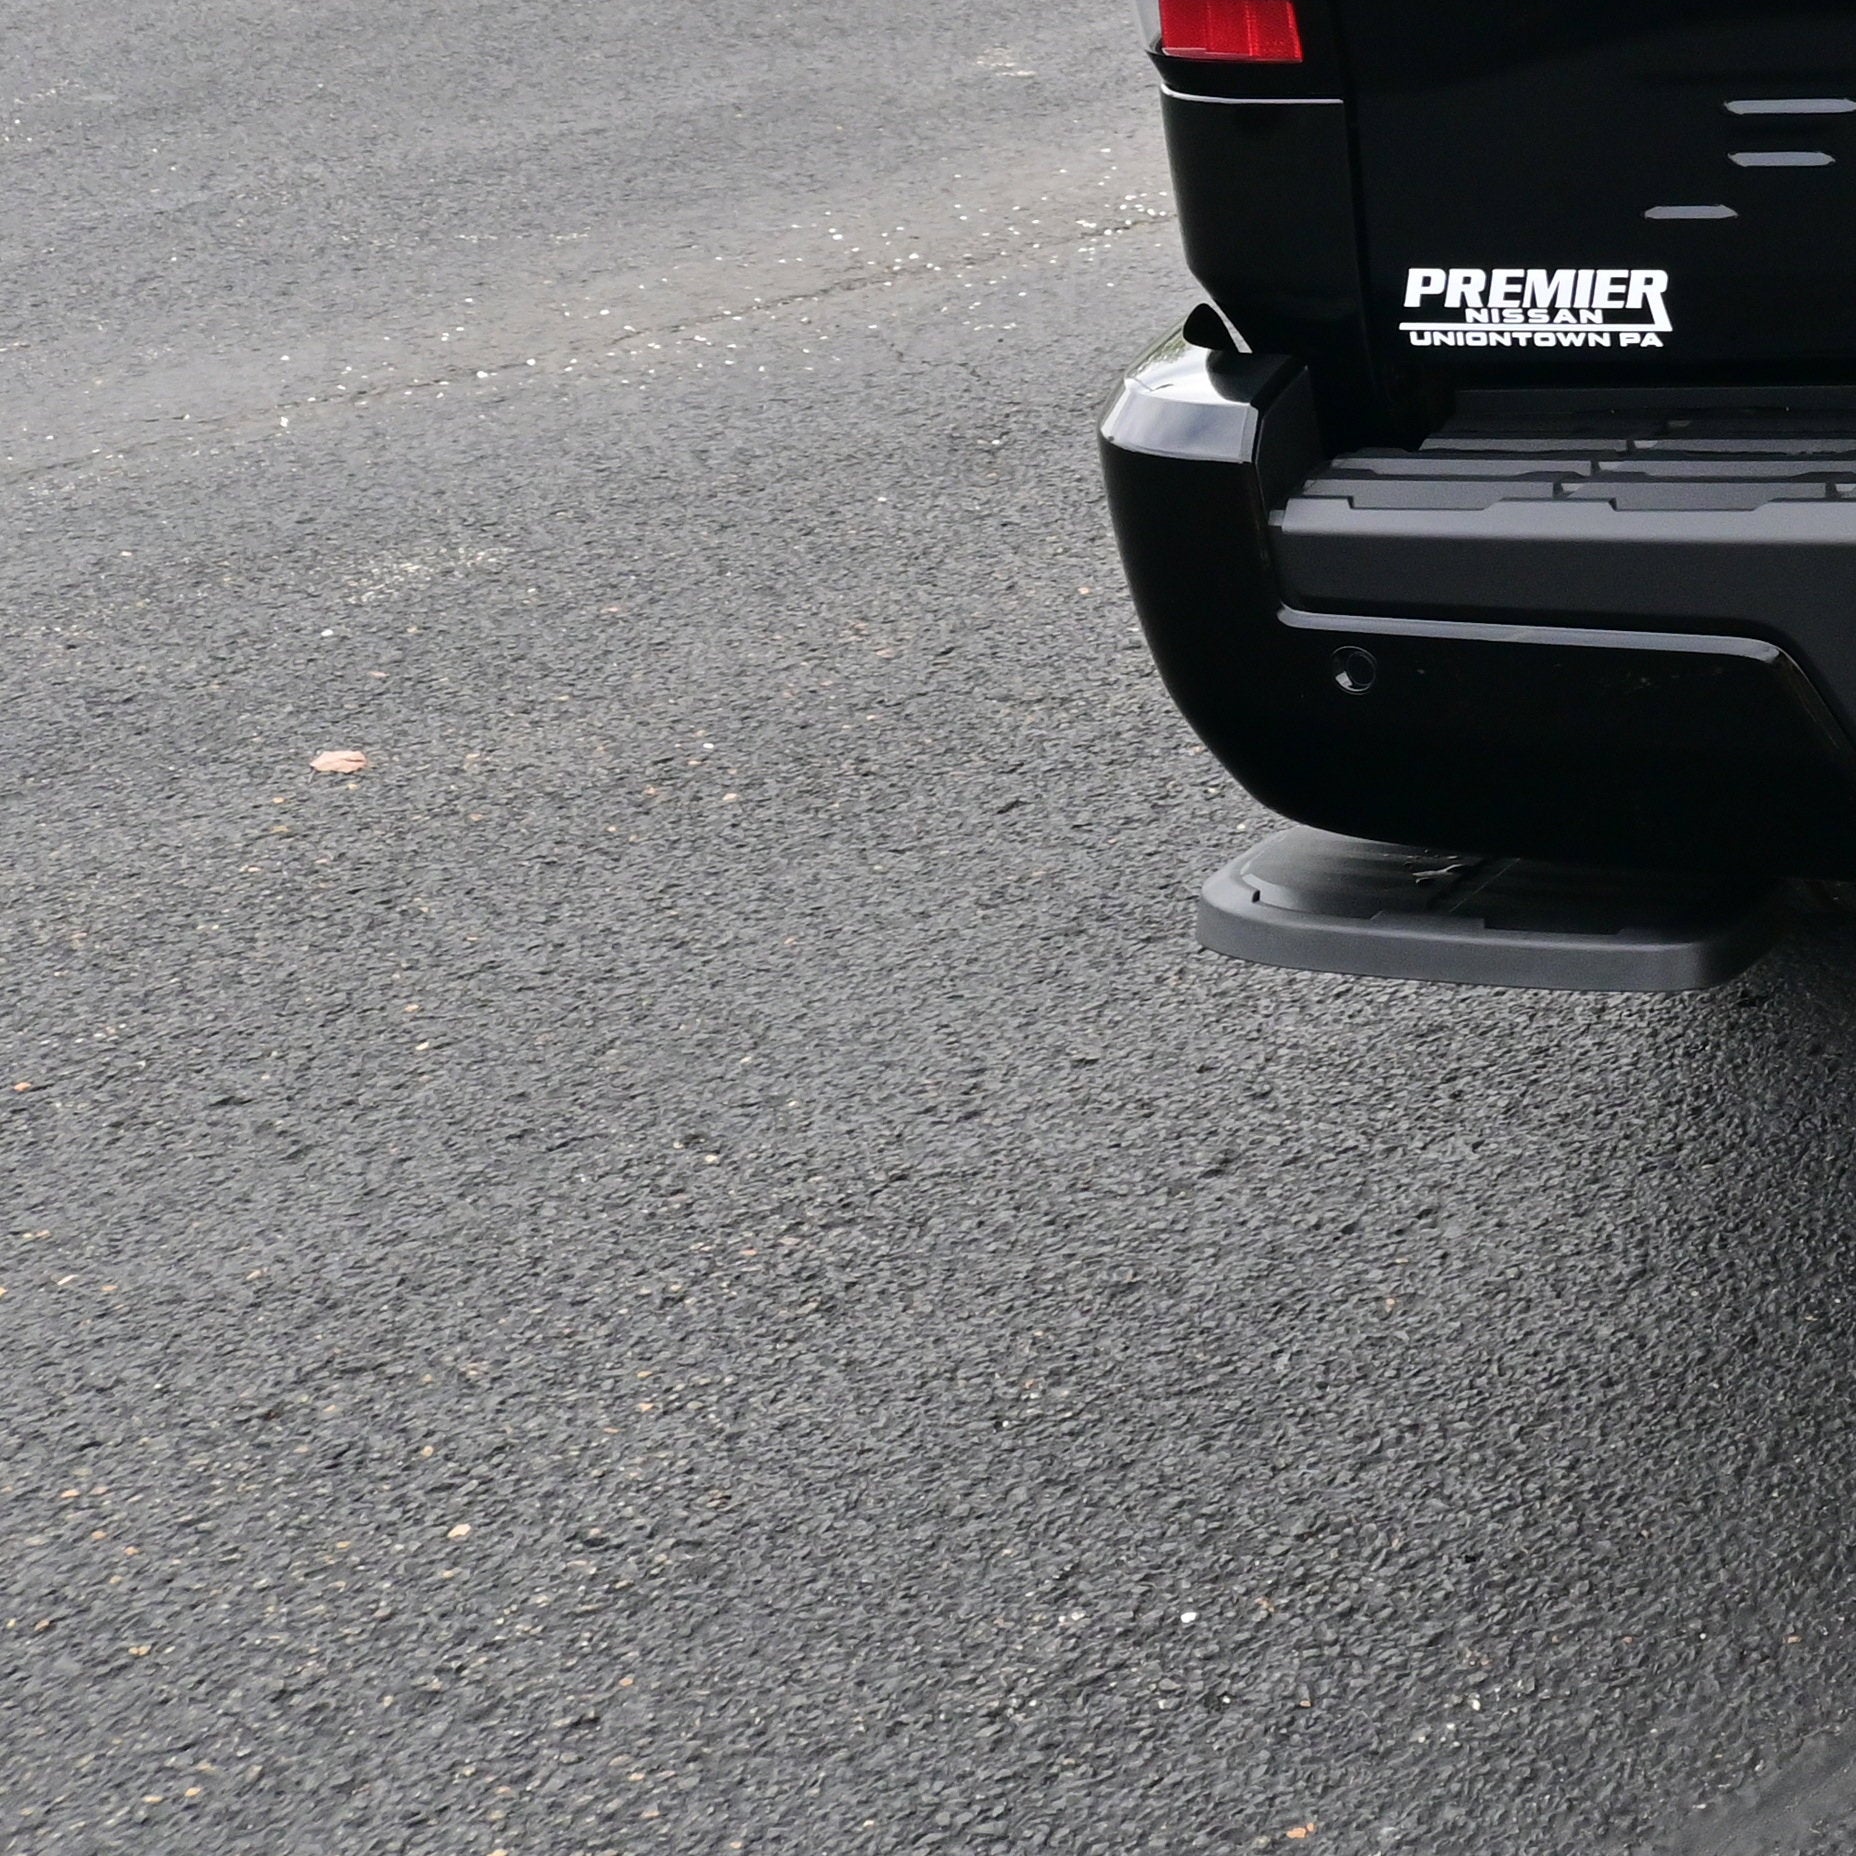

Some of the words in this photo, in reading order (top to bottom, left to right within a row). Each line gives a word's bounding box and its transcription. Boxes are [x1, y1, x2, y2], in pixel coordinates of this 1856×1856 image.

[1403, 267, 1672, 331] PREMIER
[1465, 308, 1604, 324] NISSAN
[1409, 330, 1612, 348] UNIONTOWN
[1619, 331, 1664, 348] PA
